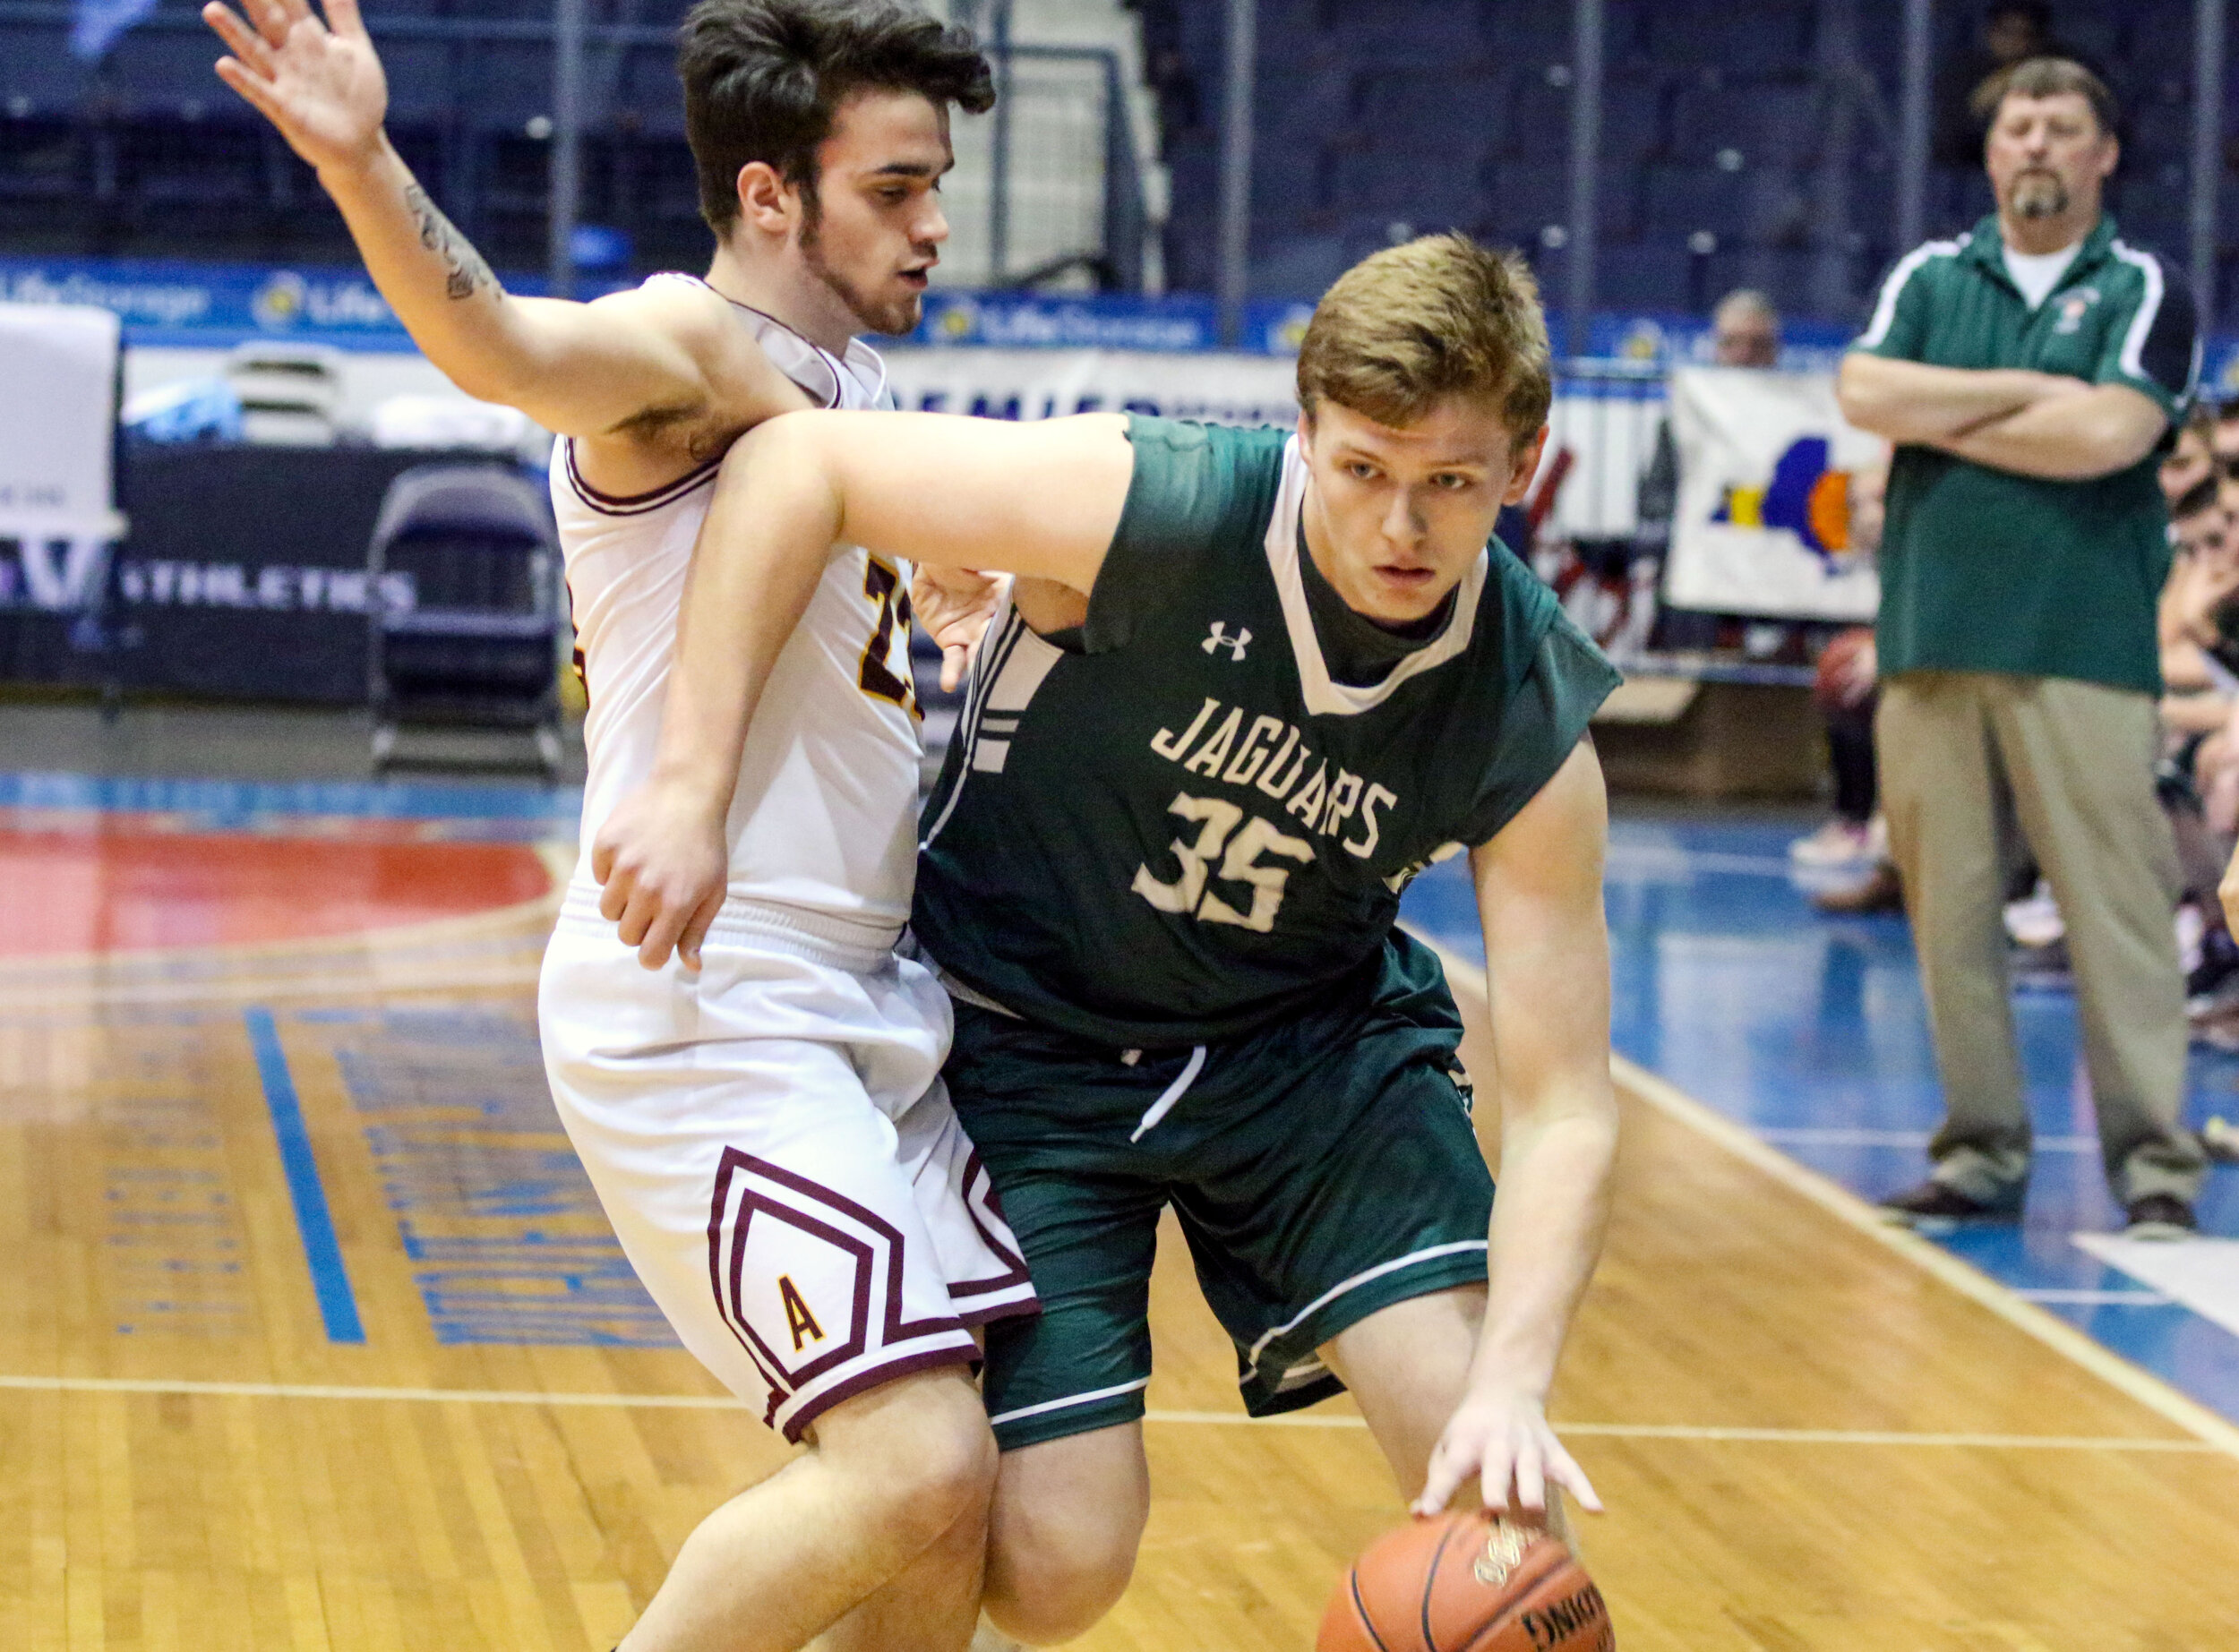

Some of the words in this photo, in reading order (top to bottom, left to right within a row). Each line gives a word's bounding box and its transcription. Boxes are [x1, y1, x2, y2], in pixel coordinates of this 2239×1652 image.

[1150, 697, 1397, 860] JAGUARS
[1131, 792, 1317, 933] 35
[776, 1272, 826, 1353] A
